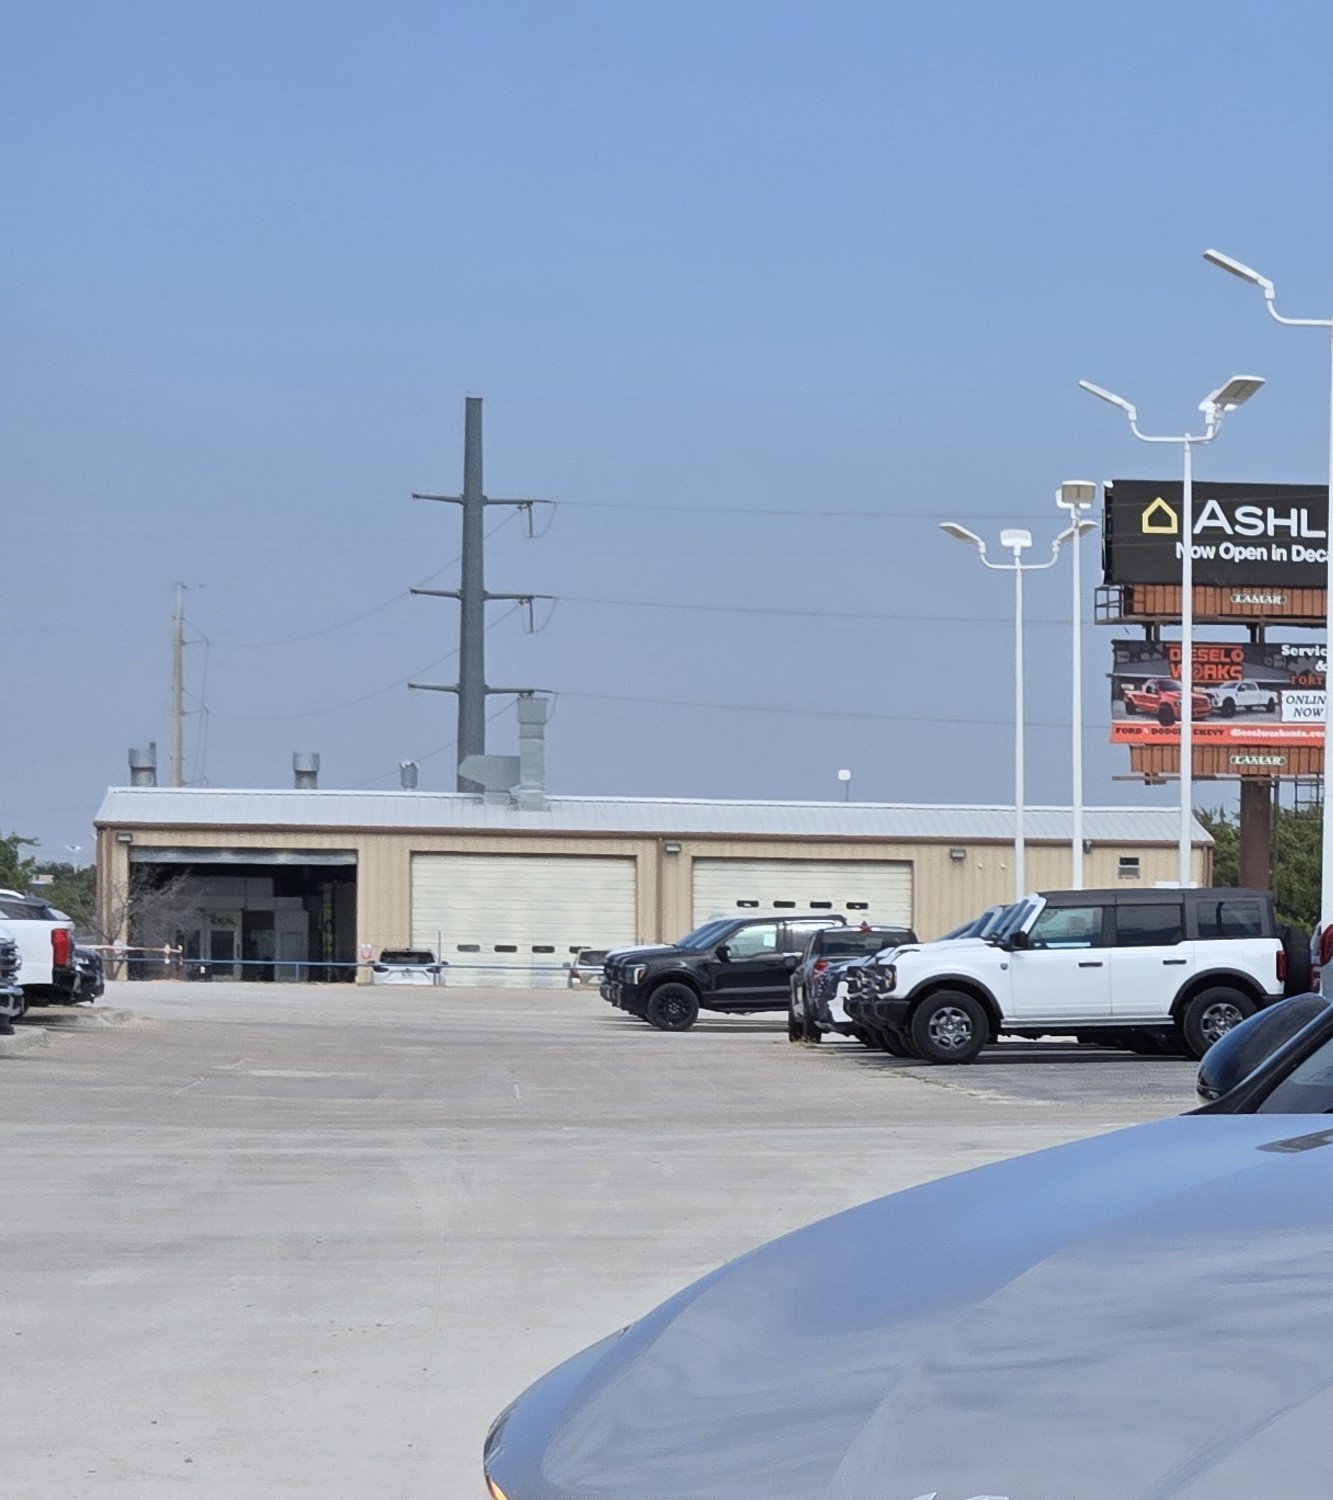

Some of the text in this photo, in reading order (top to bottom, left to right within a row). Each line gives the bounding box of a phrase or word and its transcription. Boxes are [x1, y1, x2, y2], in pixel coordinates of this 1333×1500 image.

[1175, 541, 1216, 560] Now
[1219, 541, 1268, 563] Open
[1271, 544, 1288, 561] in
[1293, 708, 1324, 717] NOW
